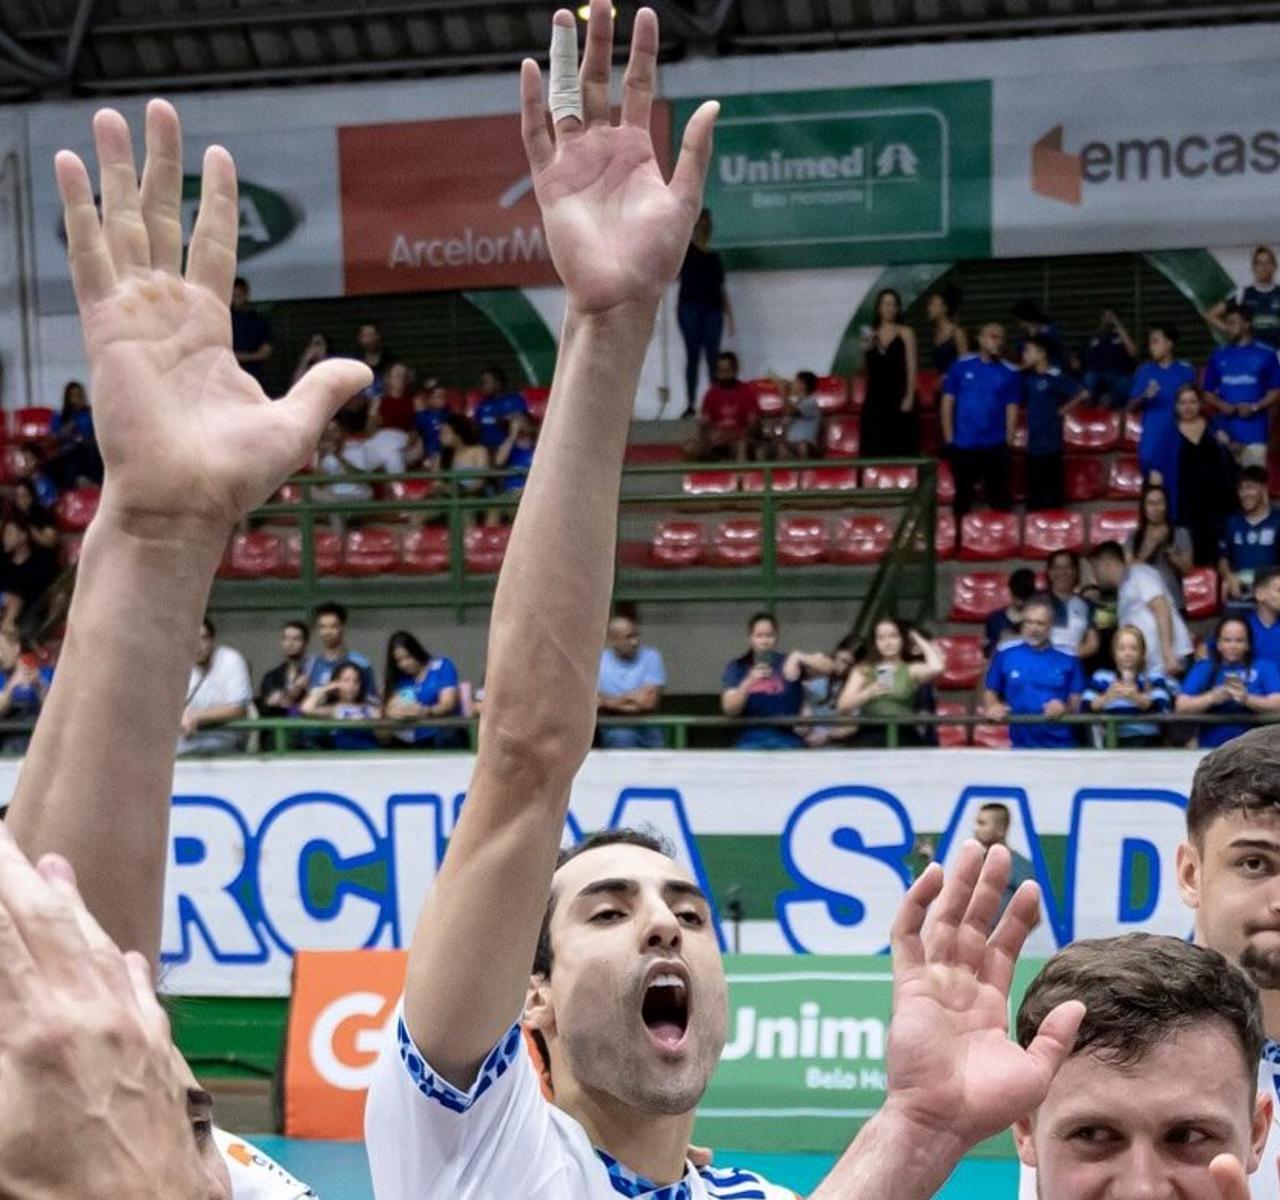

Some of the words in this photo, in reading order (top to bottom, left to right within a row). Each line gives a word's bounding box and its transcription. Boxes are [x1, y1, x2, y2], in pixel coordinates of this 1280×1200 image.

[720, 147, 864, 185] Unimed
[388, 228, 550, 269] ArcelorM
[719, 1001, 886, 1061] Unim
[805, 1065, 858, 1090] Belo
